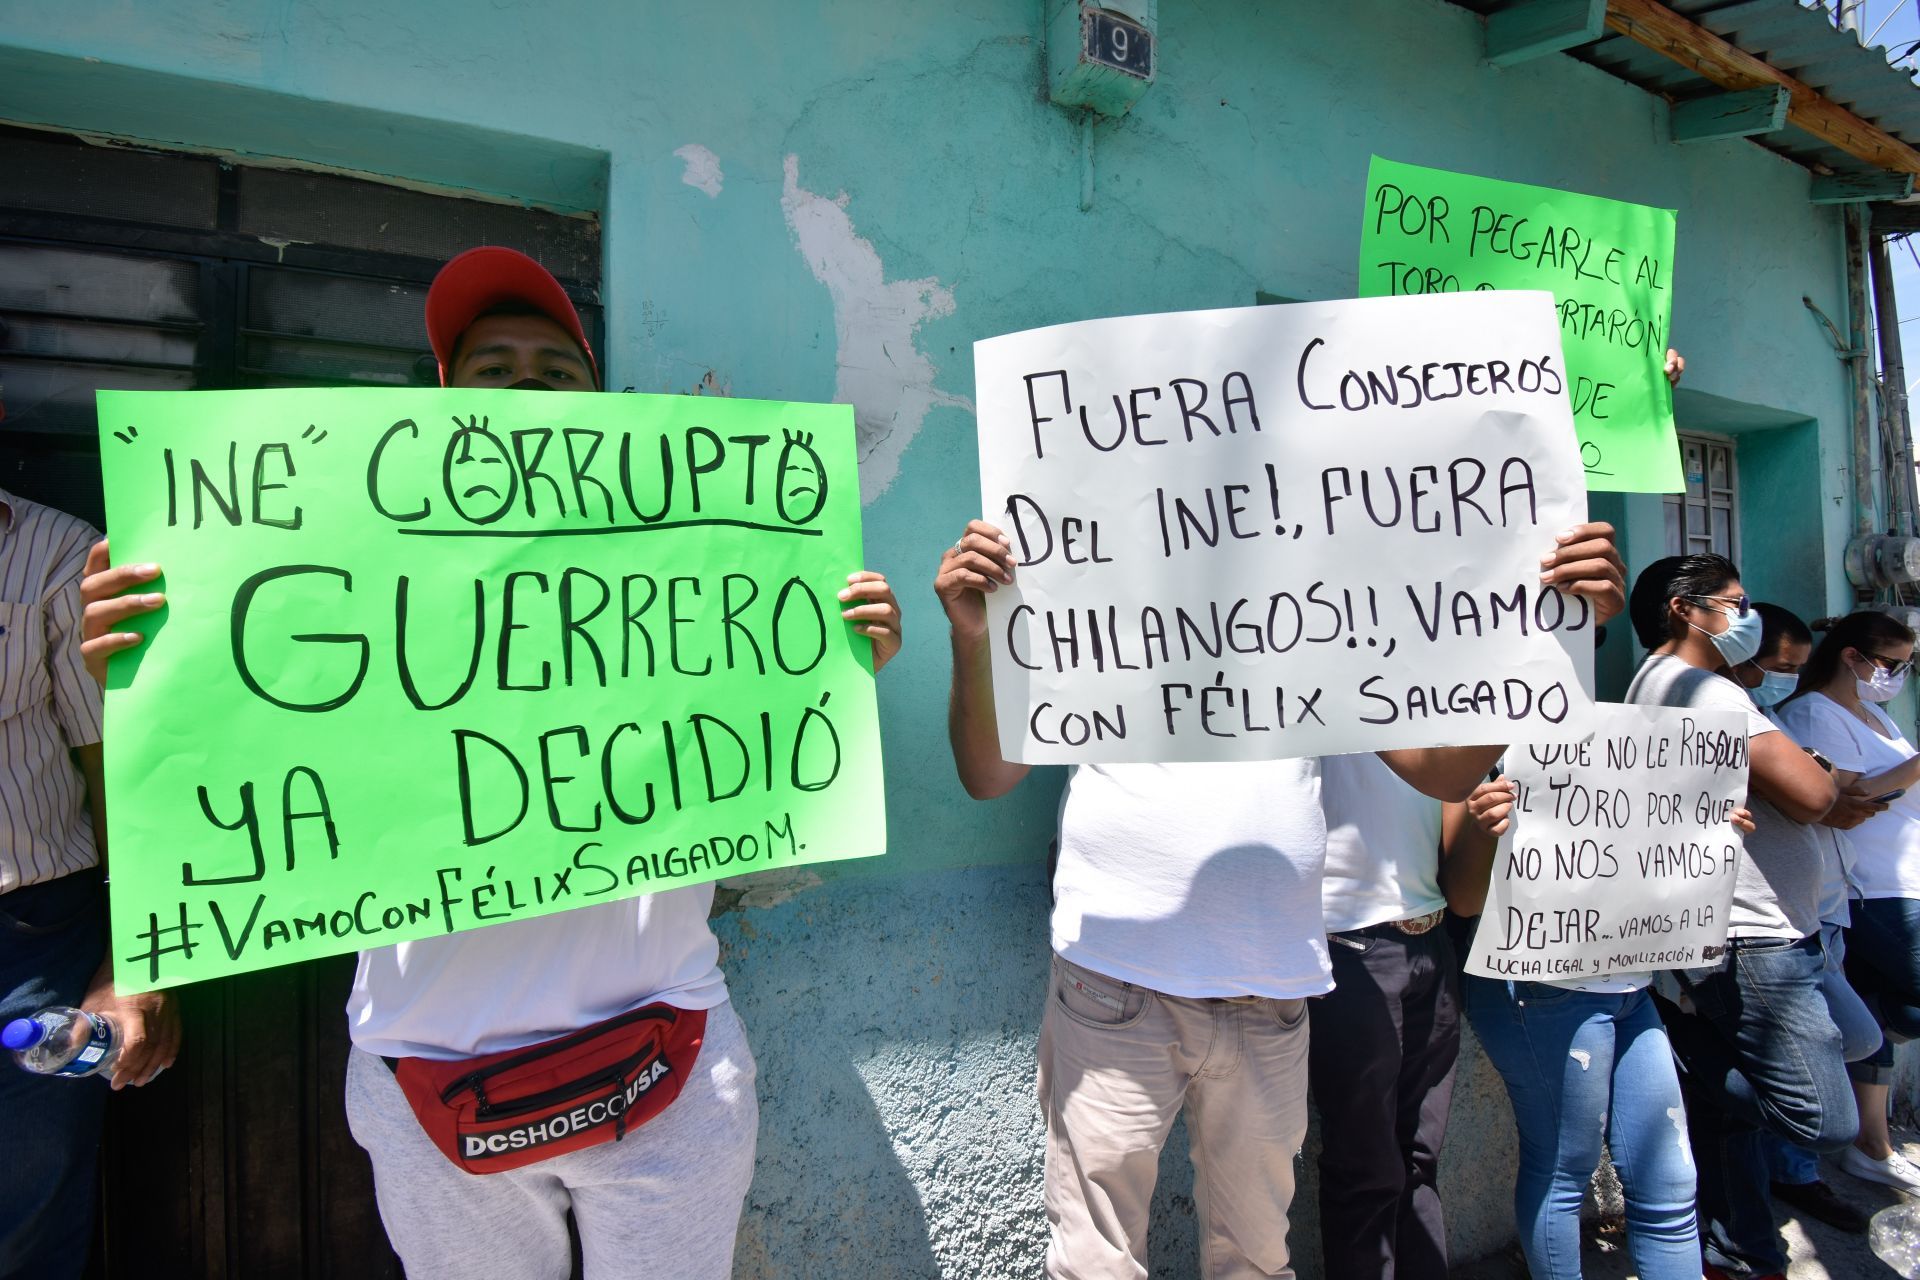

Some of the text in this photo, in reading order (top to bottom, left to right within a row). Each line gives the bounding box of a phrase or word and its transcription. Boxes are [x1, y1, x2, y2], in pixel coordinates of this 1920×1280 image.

[1112, 26, 1128, 62] 9
[1375, 184, 1664, 290] POR PEGARLE AL
[1555, 298, 1662, 358] RTARÓN
[1023, 337, 1563, 460] FUERA CONSEJEROS
[1573, 376, 1616, 419] DE
[366, 415, 828, 526] CORRUPTO
[1005, 494, 1114, 568] DEL
[1322, 457, 1538, 536] FUERA
[230, 564, 828, 713] GUERRERO
[1031, 672, 1569, 747] CON FÉLIX SALGADO
[1607, 735, 1637, 770] NO
[1646, 736, 1668, 769] LE
[182, 692, 842, 887] YA DECIDIÓ
[1550, 773, 1630, 829] TORO
[1647, 792, 1683, 828] POR
[1695, 791, 1734, 830] QUE
[1506, 839, 1735, 881] NO NOS VAMOS A
[1618, 914, 1673, 939] VAMOS
[1680, 909, 1690, 930] A
[1697, 905, 1714, 927] LA
[1486, 955, 1541, 975] LUCHA
[1547, 957, 1584, 973] LEGAL
[1608, 946, 1694, 969] MOVILIZACIÓN
